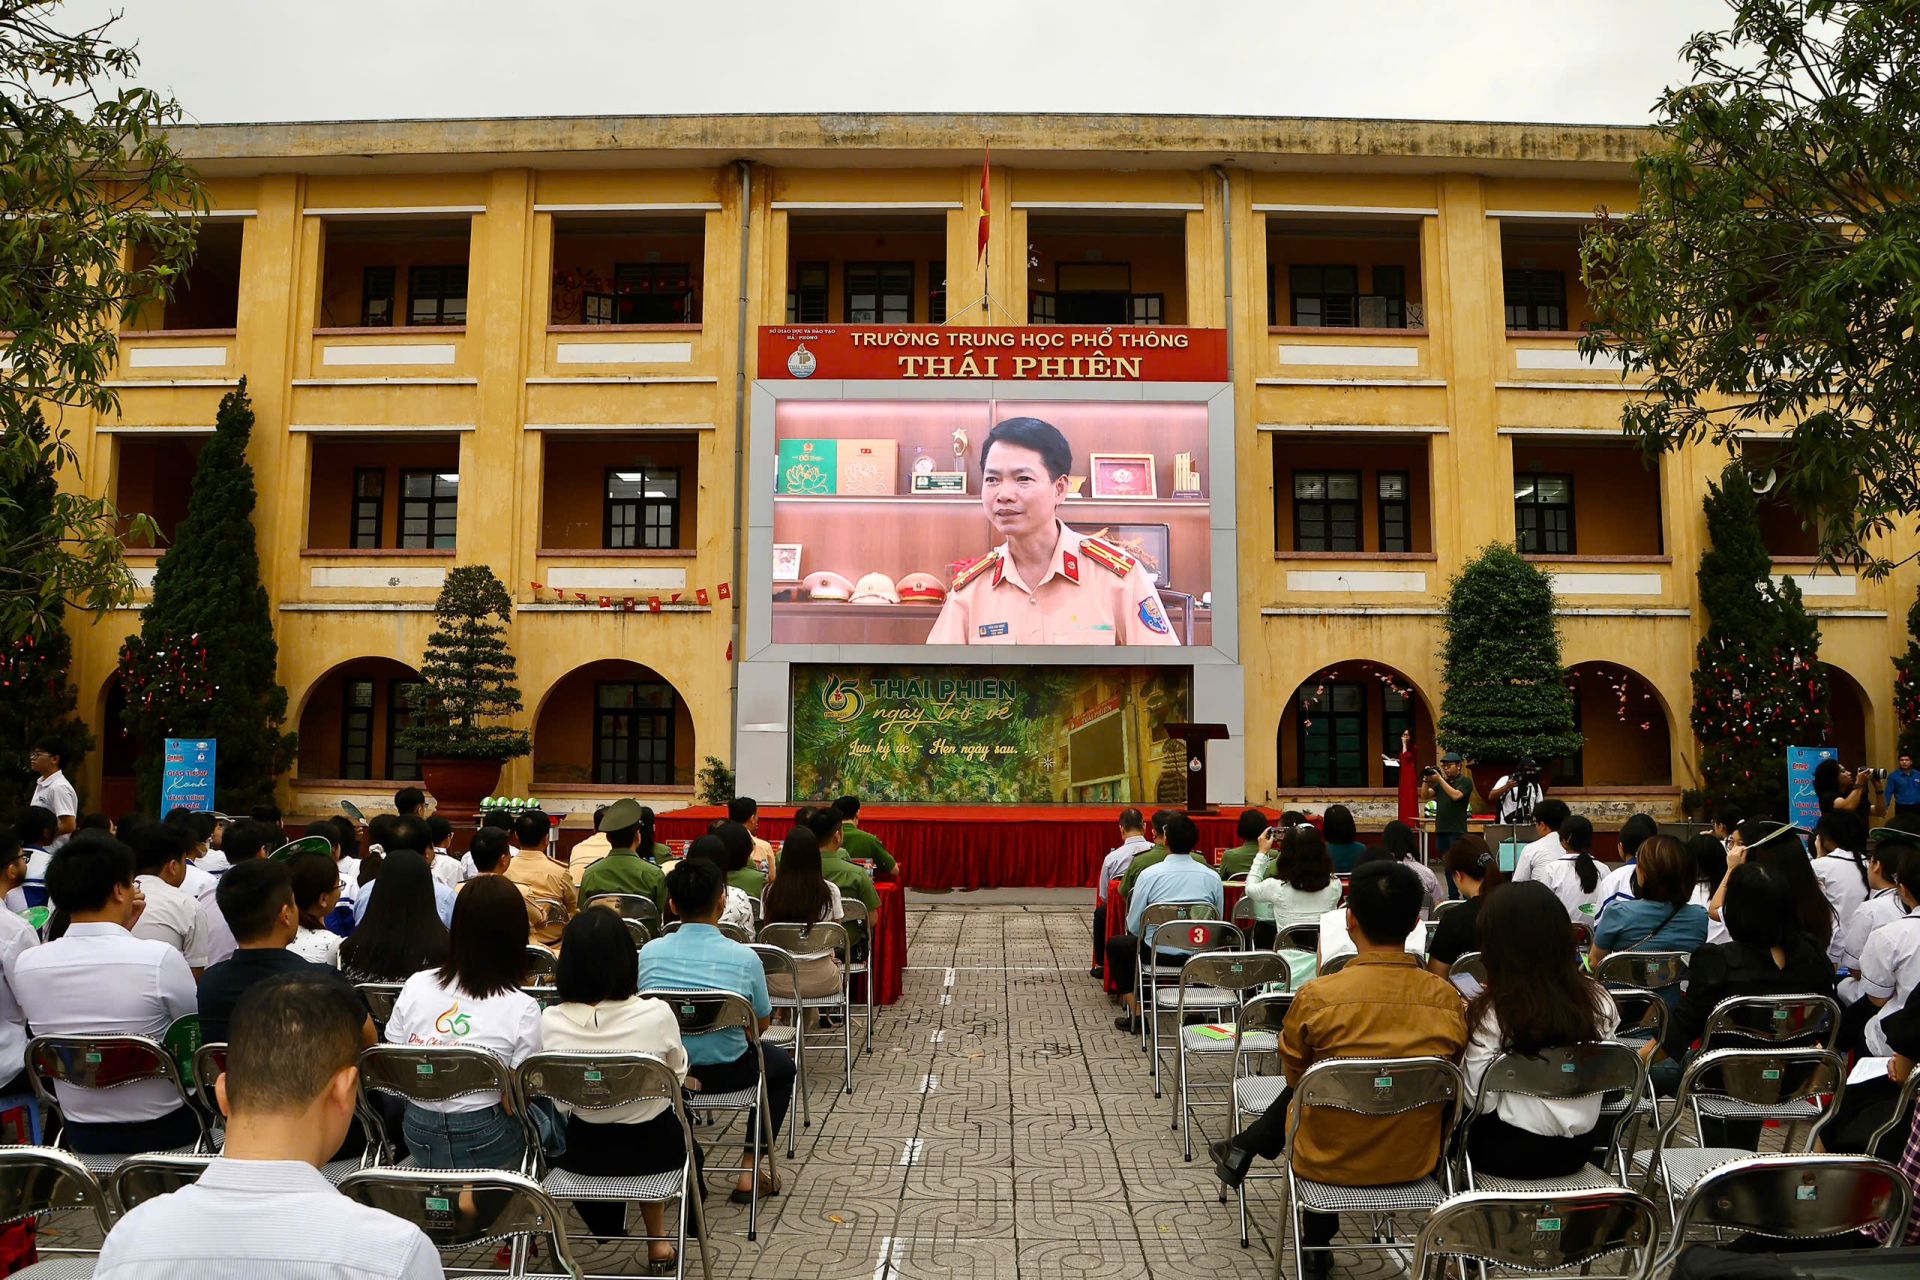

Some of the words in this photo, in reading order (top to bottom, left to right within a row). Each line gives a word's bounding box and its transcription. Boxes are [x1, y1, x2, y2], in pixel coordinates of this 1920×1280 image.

[851, 329, 939, 347] TRƯỜNG
[947, 332, 1015, 347] TRUNG
[1021, 332, 1064, 350] HỌC
[1072, 327, 1113, 347] PHỔ
[1119, 329, 1189, 347] THÔNG
[898, 350, 999, 378] THÁI
[1012, 350, 1143, 378] PHIÊN
[871, 675, 930, 700] THÁI
[938, 677, 1017, 700] PHIÊN
[873, 703, 936, 734] ngày
[931, 691, 974, 721] trở
[986, 697, 1014, 720] về
[848, 738, 872, 756] Lưu
[876, 737, 890, 760] ký
[896, 742, 911, 754] ức
[929, 737, 957, 755] Hẹn
[960, 742, 989, 761] ngày
[166, 776, 208, 793] Xanh
[1193, 927, 1204, 944] 3
[435, 999, 473, 1037] 65
